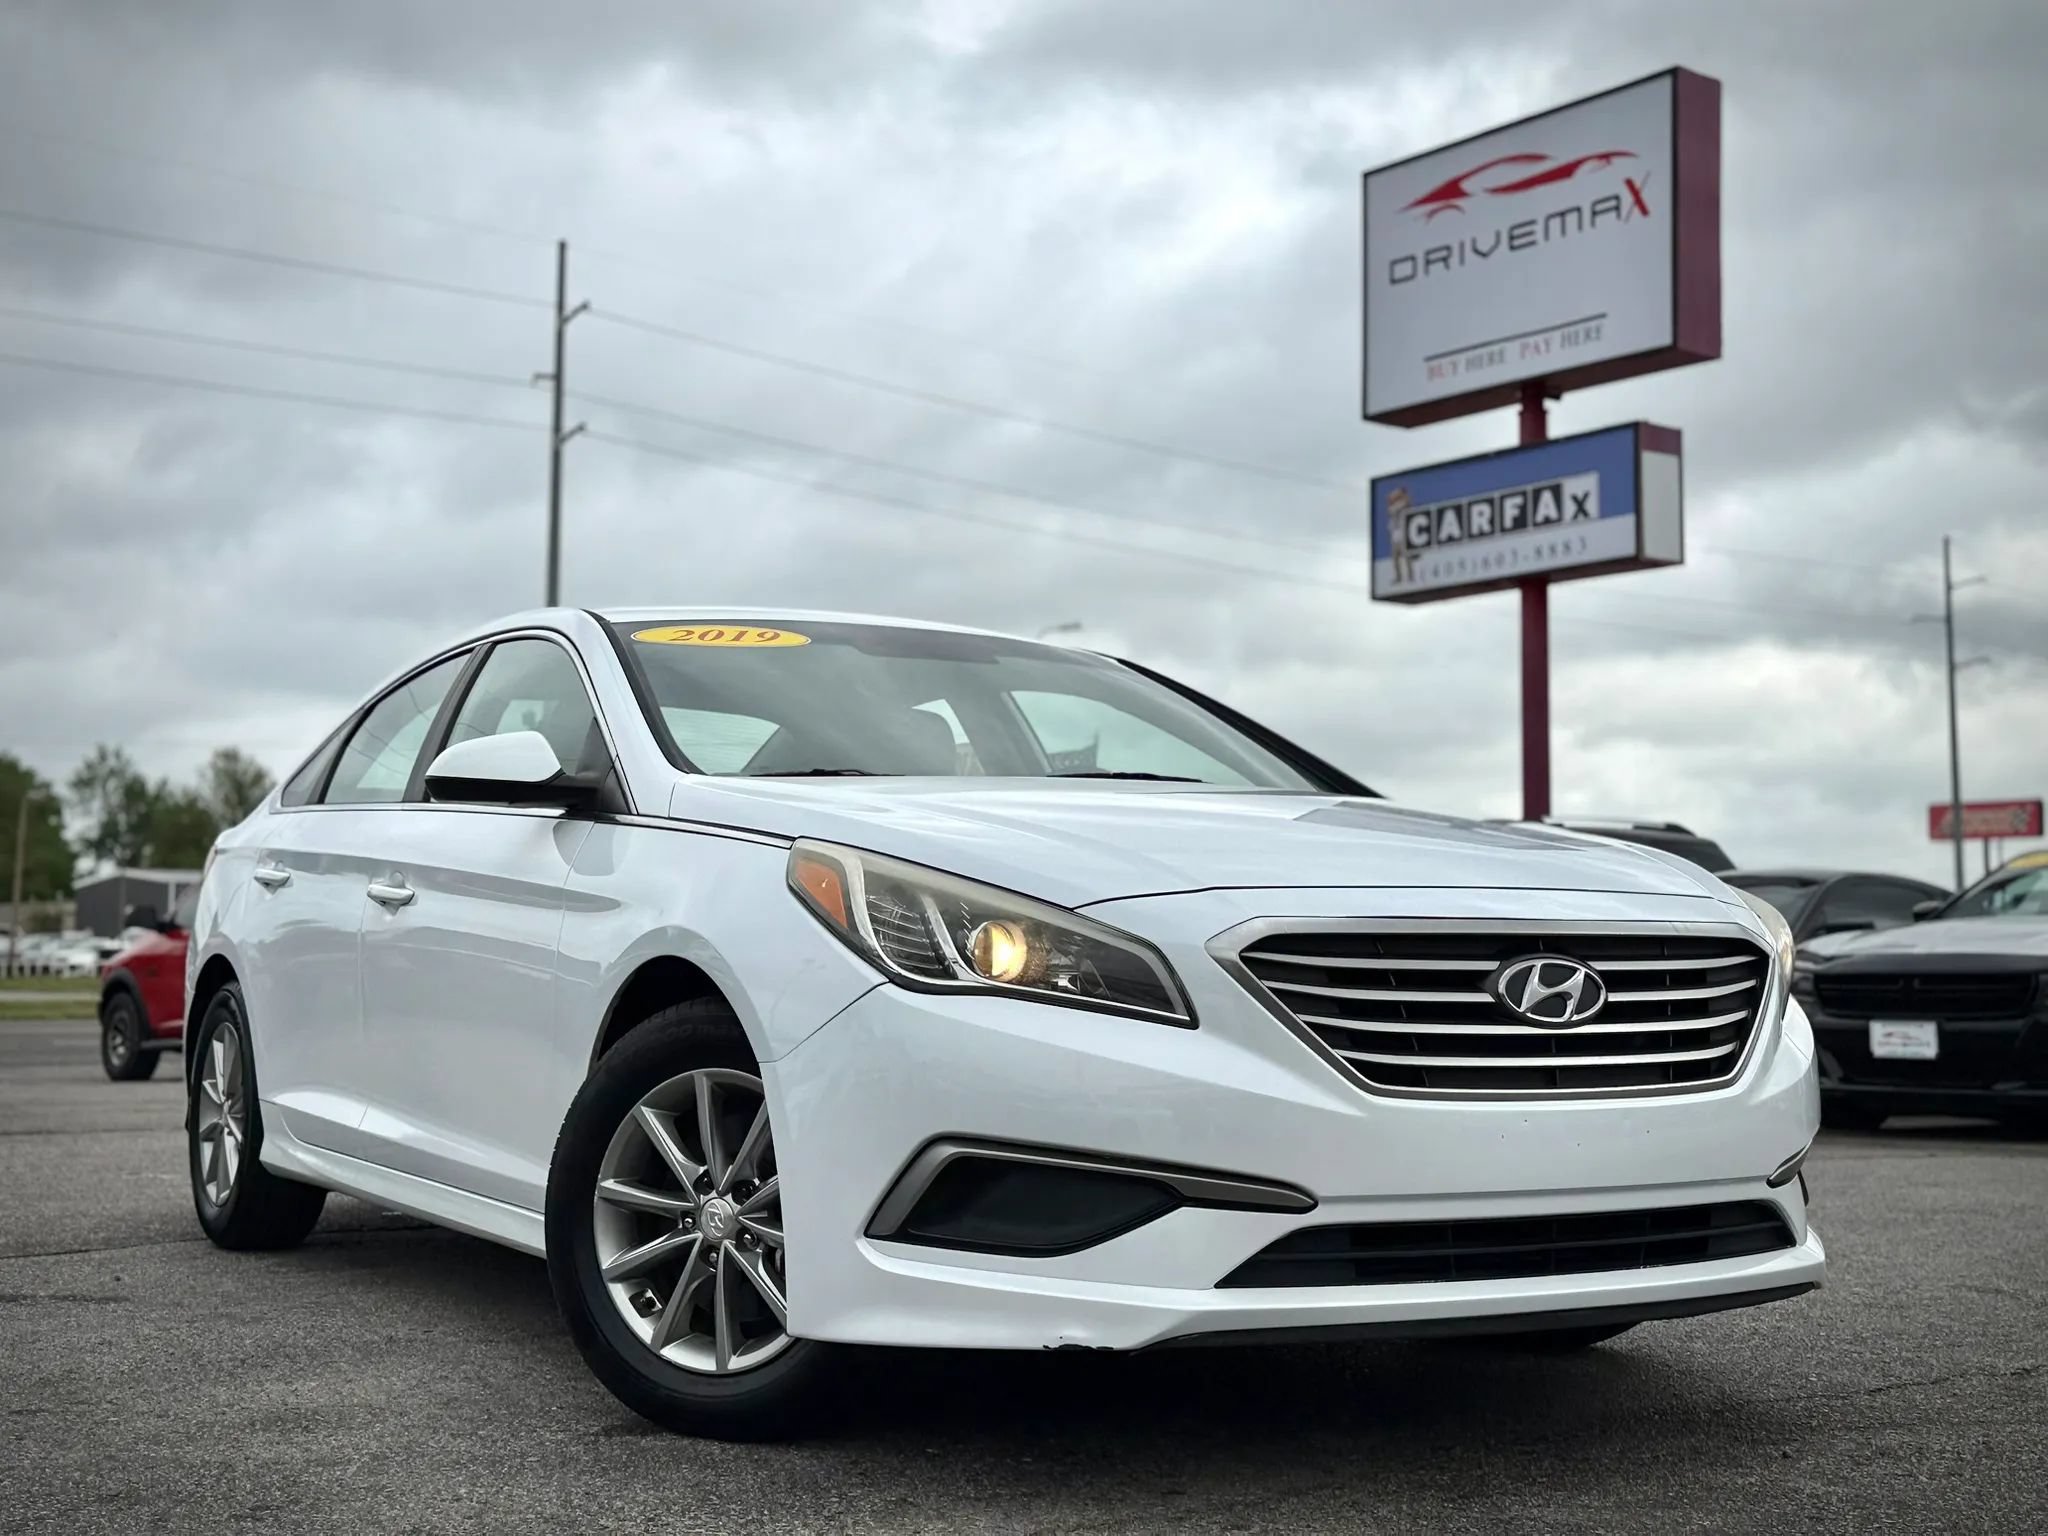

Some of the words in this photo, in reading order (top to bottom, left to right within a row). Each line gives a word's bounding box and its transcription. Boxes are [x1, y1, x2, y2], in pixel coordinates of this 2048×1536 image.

[1389, 171, 1651, 285] DRIVEMAX
[1464, 347, 1506, 373] HERE
[1519, 336, 1553, 360] PAY
[1559, 322, 1605, 350] HERE
[1406, 487, 1592, 546] CARFAX
[668, 629, 781, 643] 2019
